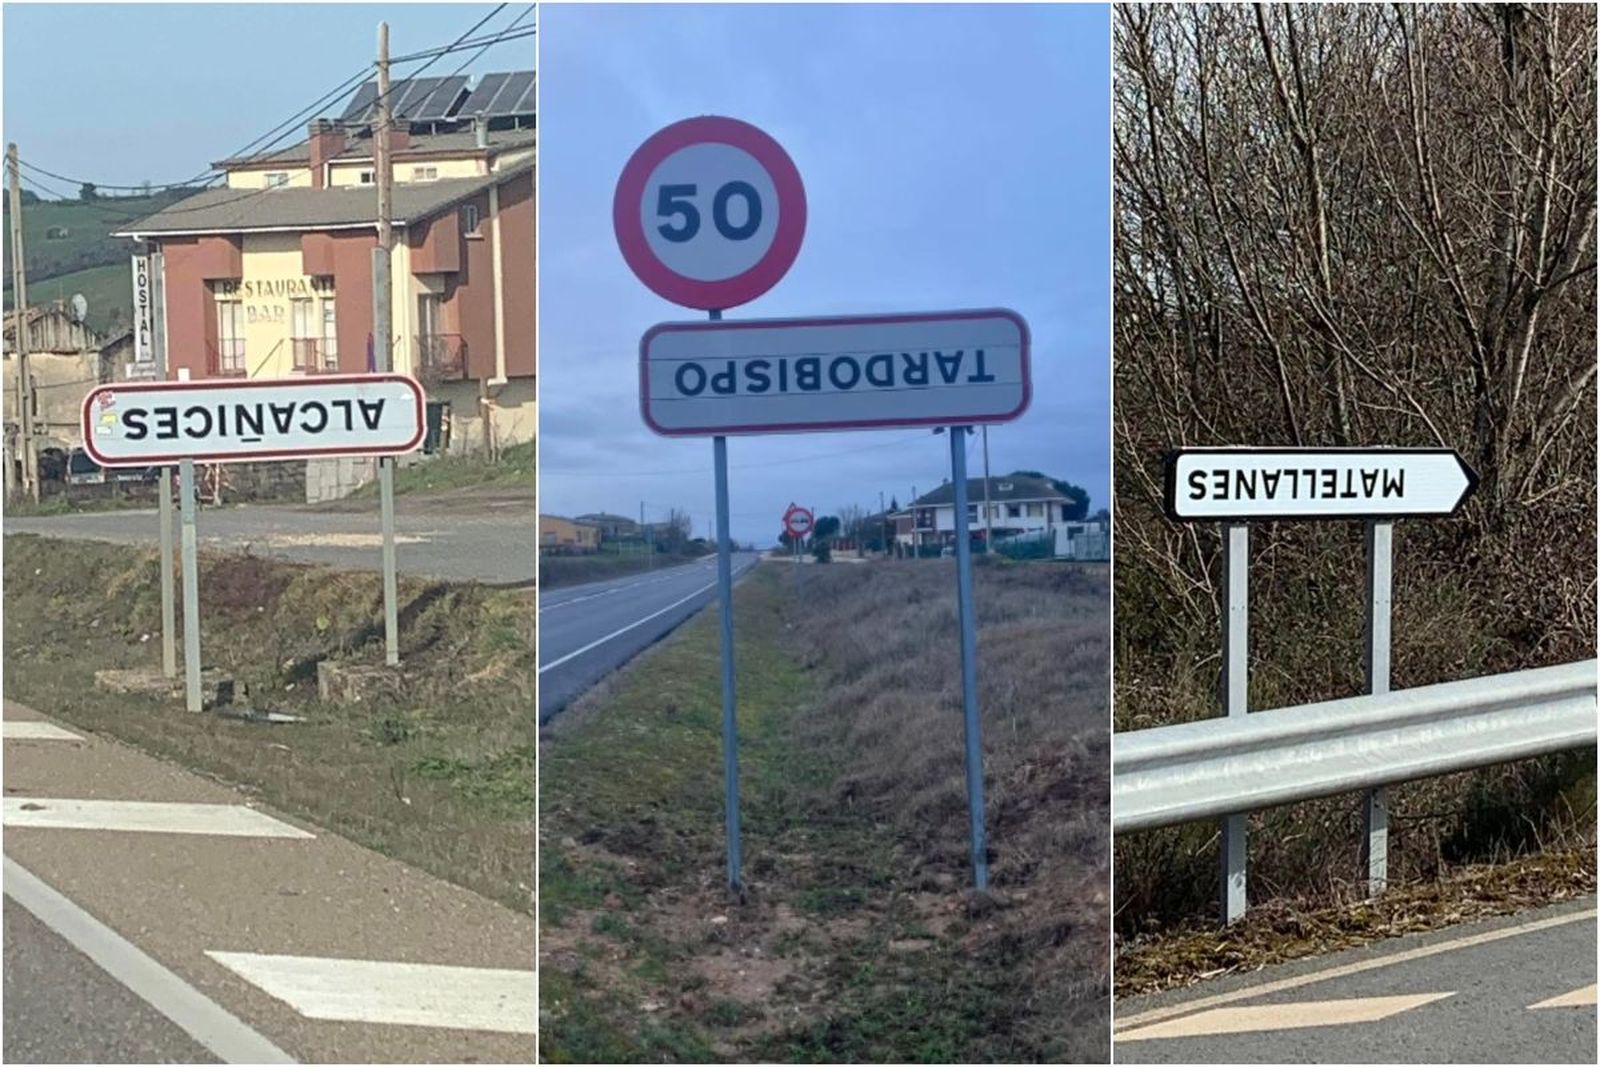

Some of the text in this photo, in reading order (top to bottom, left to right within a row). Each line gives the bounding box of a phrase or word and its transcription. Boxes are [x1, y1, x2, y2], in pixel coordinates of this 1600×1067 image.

[656, 180, 763, 243] 50
[137, 259, 148, 346] HOSTAL
[246, 304, 285, 323] BAR
[674, 349, 995, 397] TARDOBISPO
[121, 398, 386, 443] ALCAÑICES
[1187, 468, 1405, 500] MATELLANES
